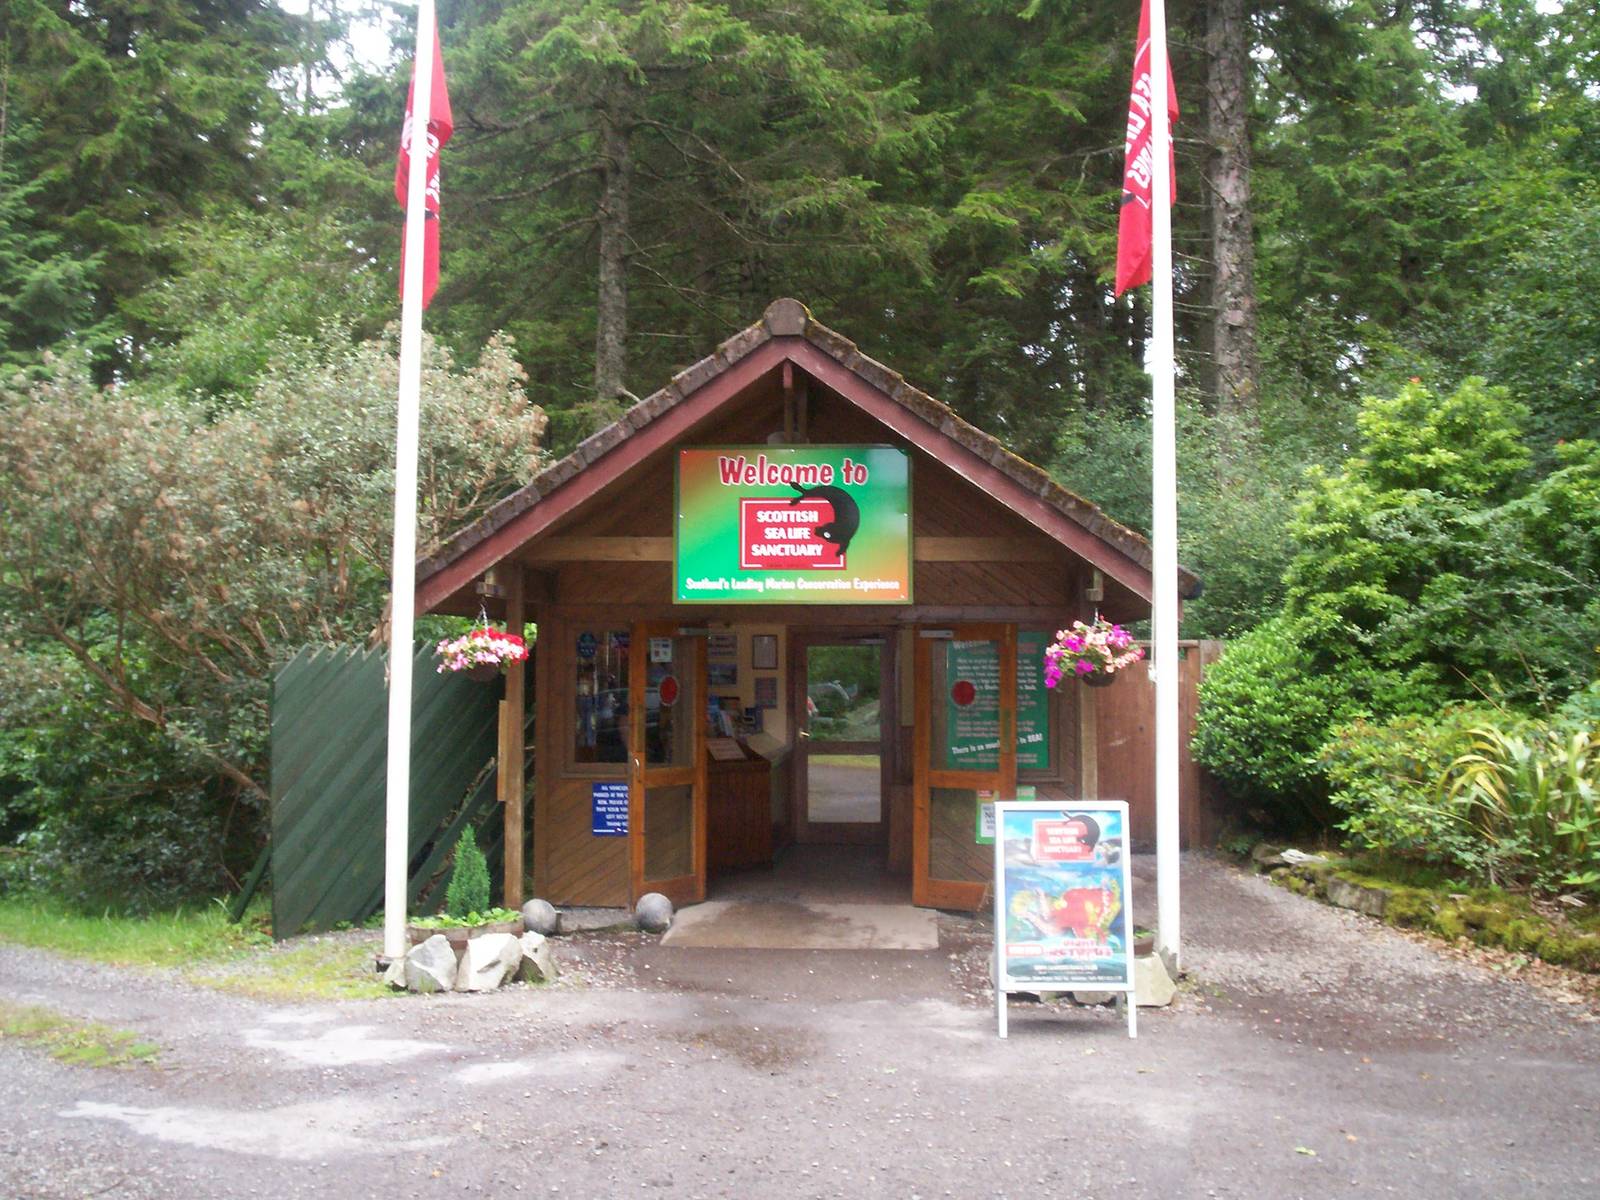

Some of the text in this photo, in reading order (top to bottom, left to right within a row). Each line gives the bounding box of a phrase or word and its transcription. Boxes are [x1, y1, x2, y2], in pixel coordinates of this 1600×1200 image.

[719, 454, 868, 486] Welcome to
[756, 510, 819, 523] SCOTTISH
[764, 527, 811, 540] SEA LIFE
[751, 543, 823, 556] SANCTUARY
[685, 577, 900, 592] Scotland's Leading Marine Conservation Experience
